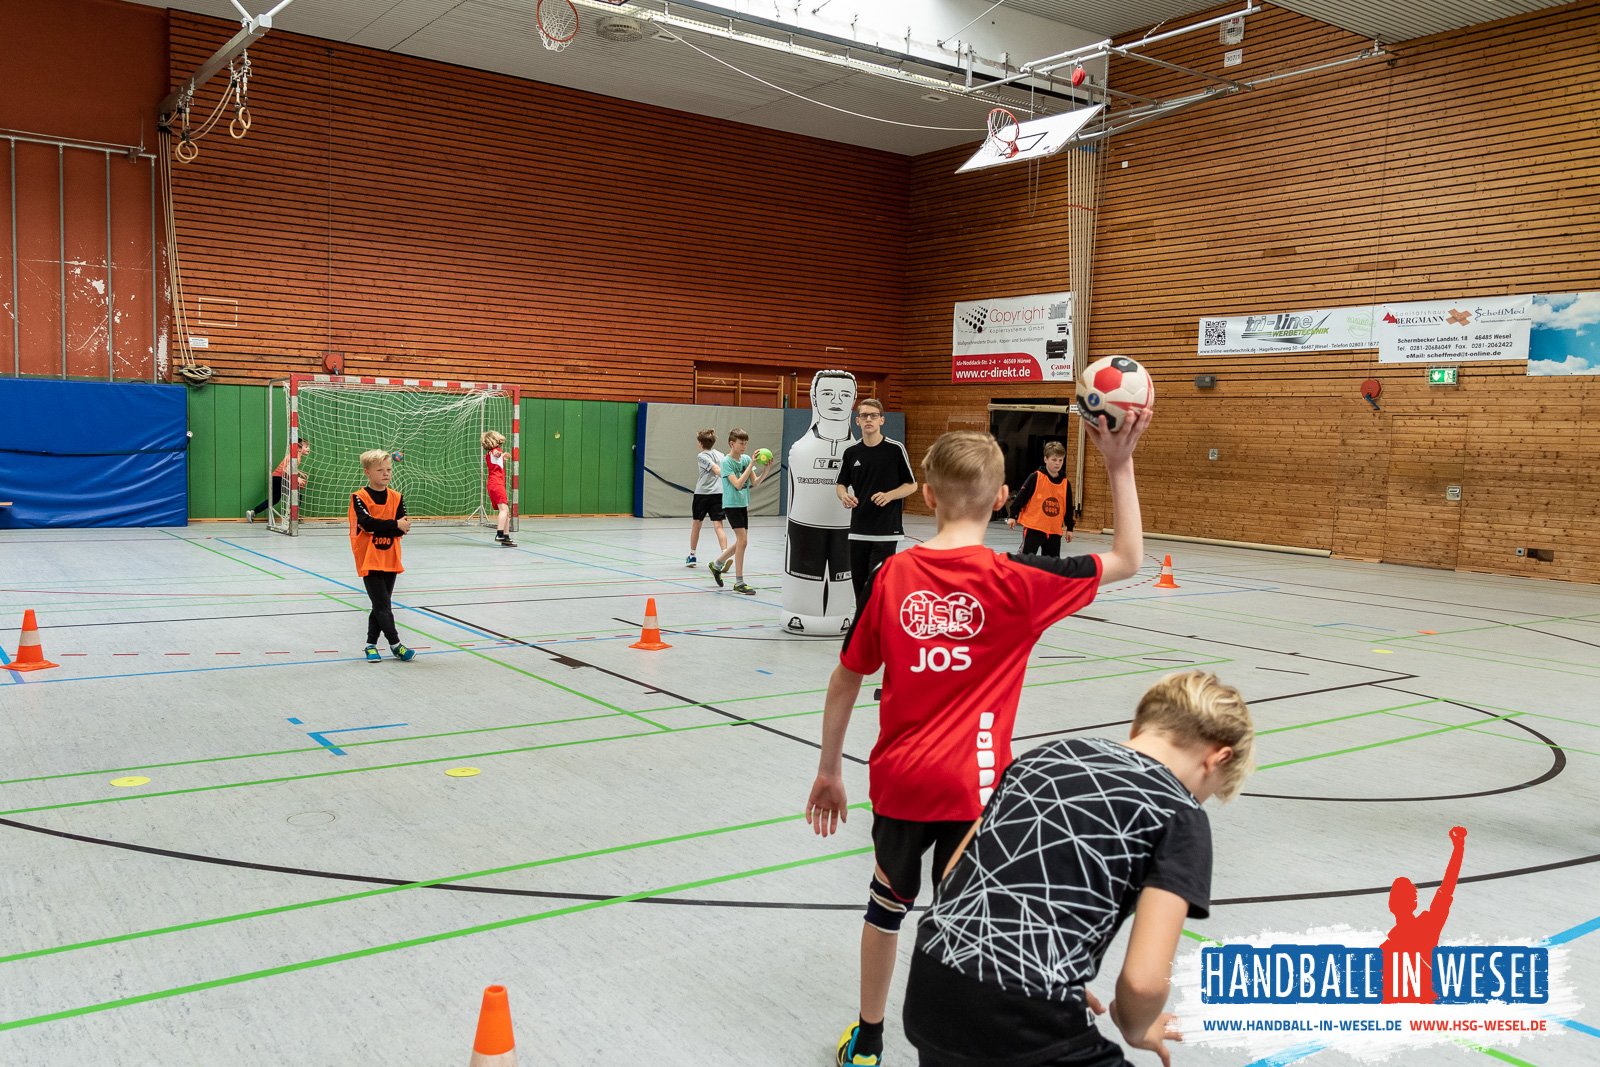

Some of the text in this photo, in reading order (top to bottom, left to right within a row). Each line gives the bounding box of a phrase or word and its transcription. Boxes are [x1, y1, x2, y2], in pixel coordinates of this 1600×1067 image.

[989, 305, 1045, 324] Copyright
[1396, 316, 1444, 324] BERGMANN
[1474, 306, 1524, 322] ScheffMed
[1245, 314, 1313, 332] tri-line
[1272, 328, 1330, 338] WERBETECHNIK
[956, 366, 1030, 378] www.cr-direkt.de
[818, 460, 826, 468] T
[910, 600, 973, 625] HSG
[916, 622, 963, 634] WESEL
[910, 646, 972, 672] JOS
